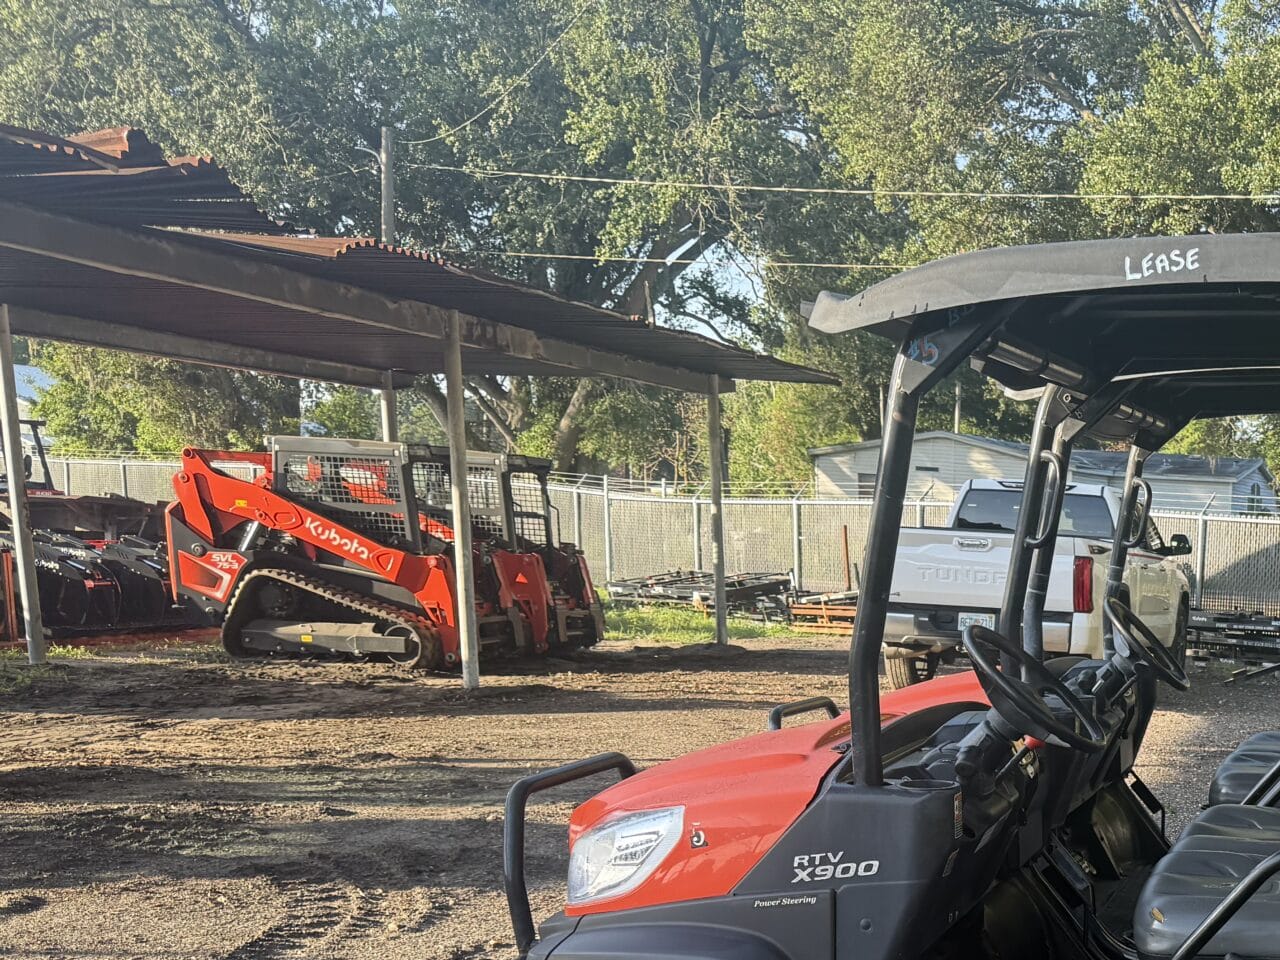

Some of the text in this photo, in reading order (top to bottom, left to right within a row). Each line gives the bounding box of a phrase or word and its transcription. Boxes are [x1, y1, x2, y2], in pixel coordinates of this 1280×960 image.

[1124, 247, 1200, 280] LEASE
[304, 516, 370, 560] Kubota
[210, 553, 237, 563] SVL
[793, 851, 844, 867] RTV
[791, 860, 880, 883] X900
[754, 895, 817, 908] Power Steering
